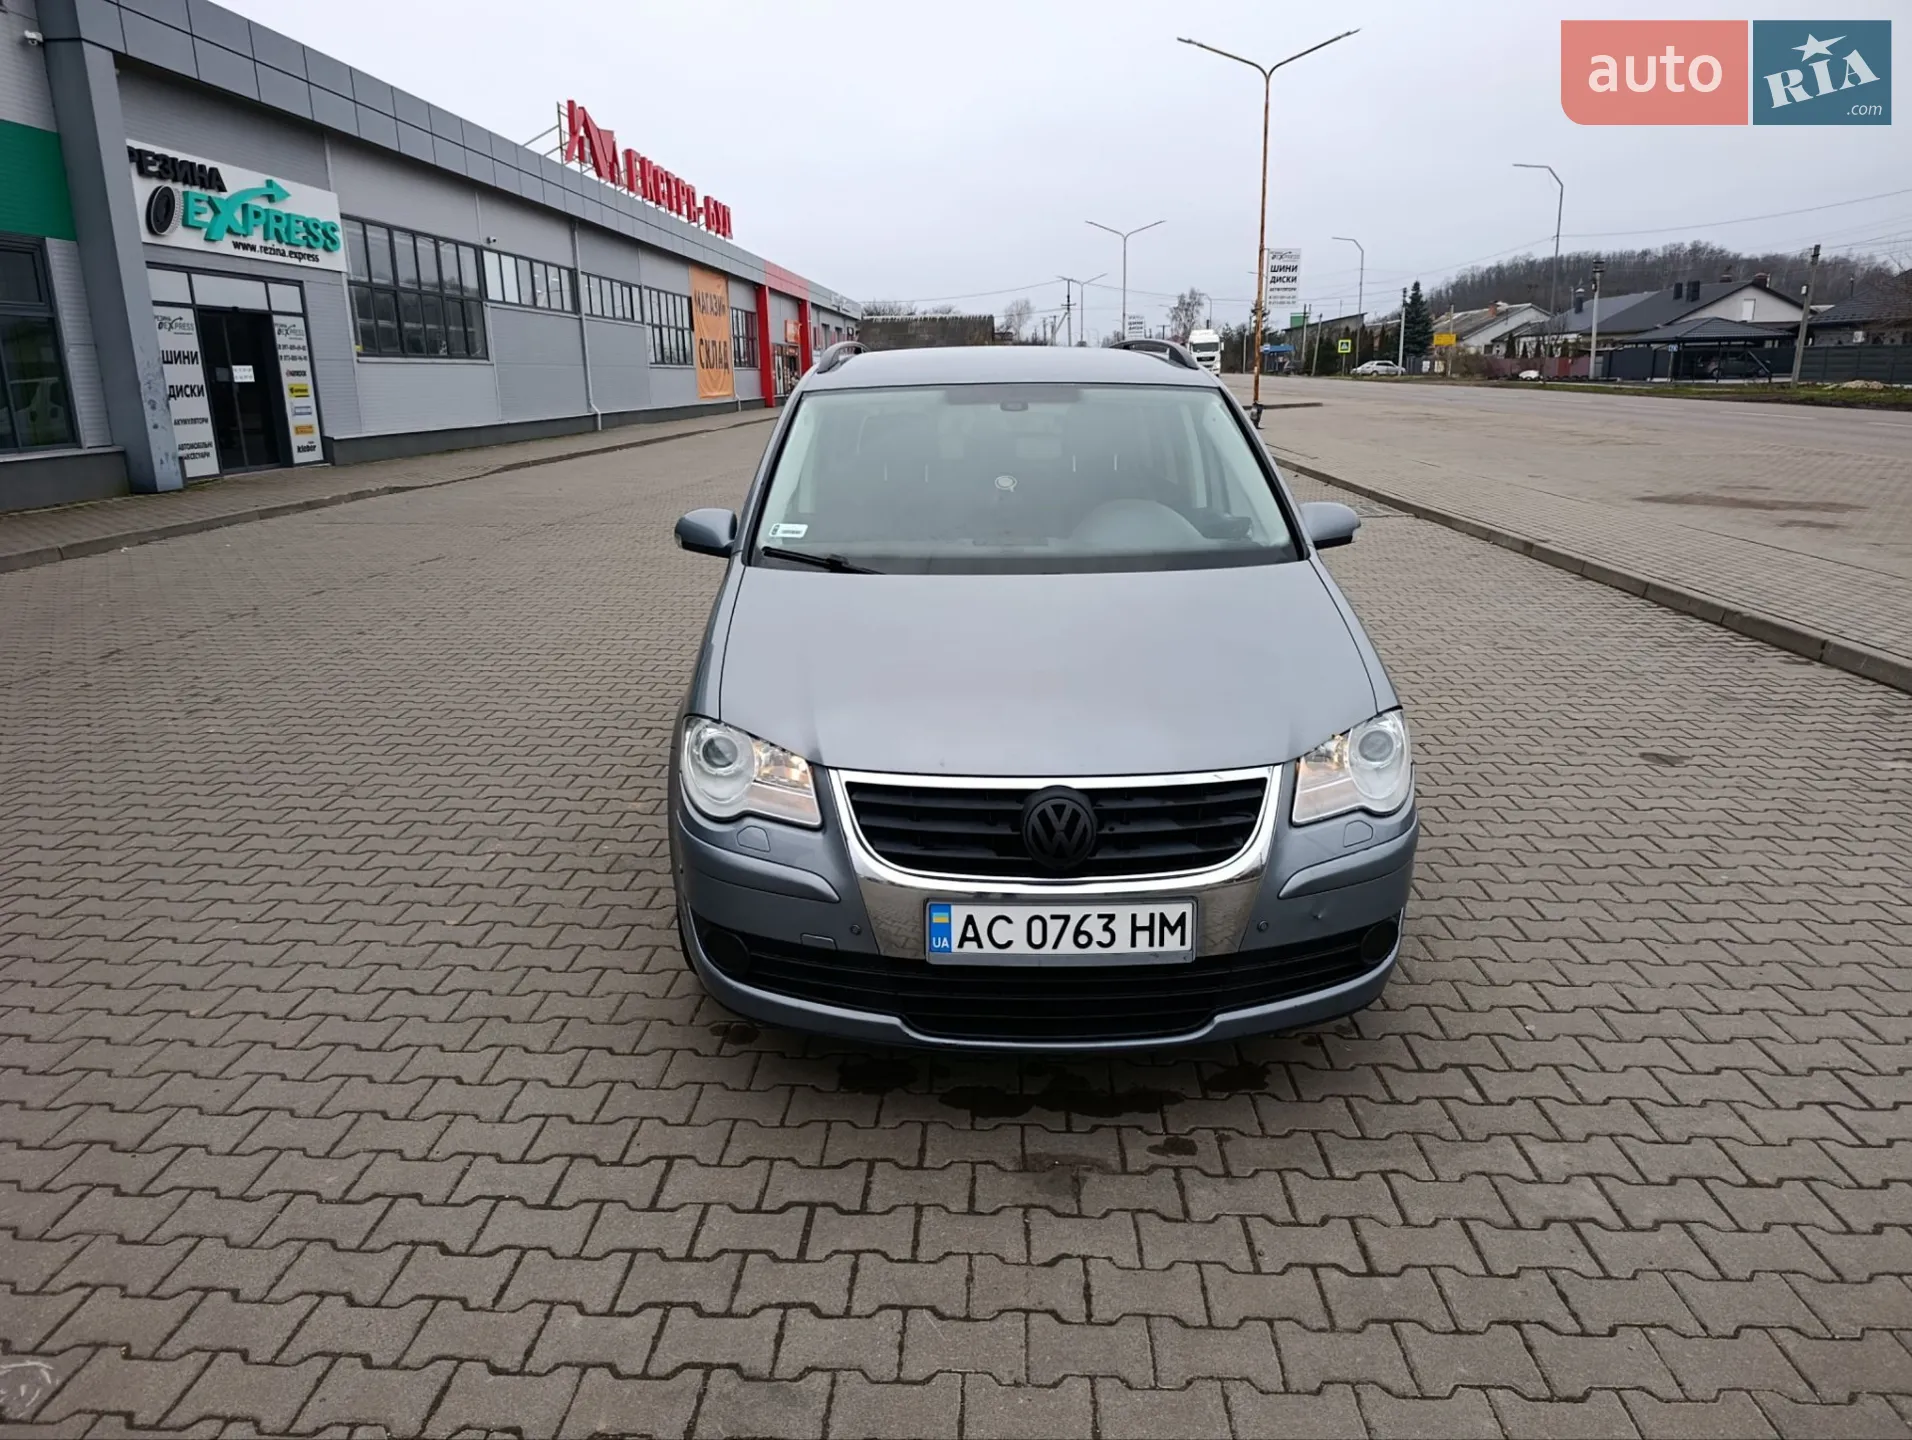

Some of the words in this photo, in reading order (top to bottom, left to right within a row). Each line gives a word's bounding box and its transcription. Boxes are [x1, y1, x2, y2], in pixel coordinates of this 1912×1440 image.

[182, 189, 341, 252] EXPRESS
[232, 240, 320, 262] www.rezina.express
[1269, 276, 1297, 284] ДИСКИ
[161, 350, 199, 365] ШИНИ
[699, 338, 730, 374] СКЛАД
[168, 385, 205, 400] ДИСКИ
[957, 914, 1014, 950] AC
[1026, 913, 1116, 950] 0763
[1130, 911, 1187, 948] HM
[932, 937, 949, 949] UA
